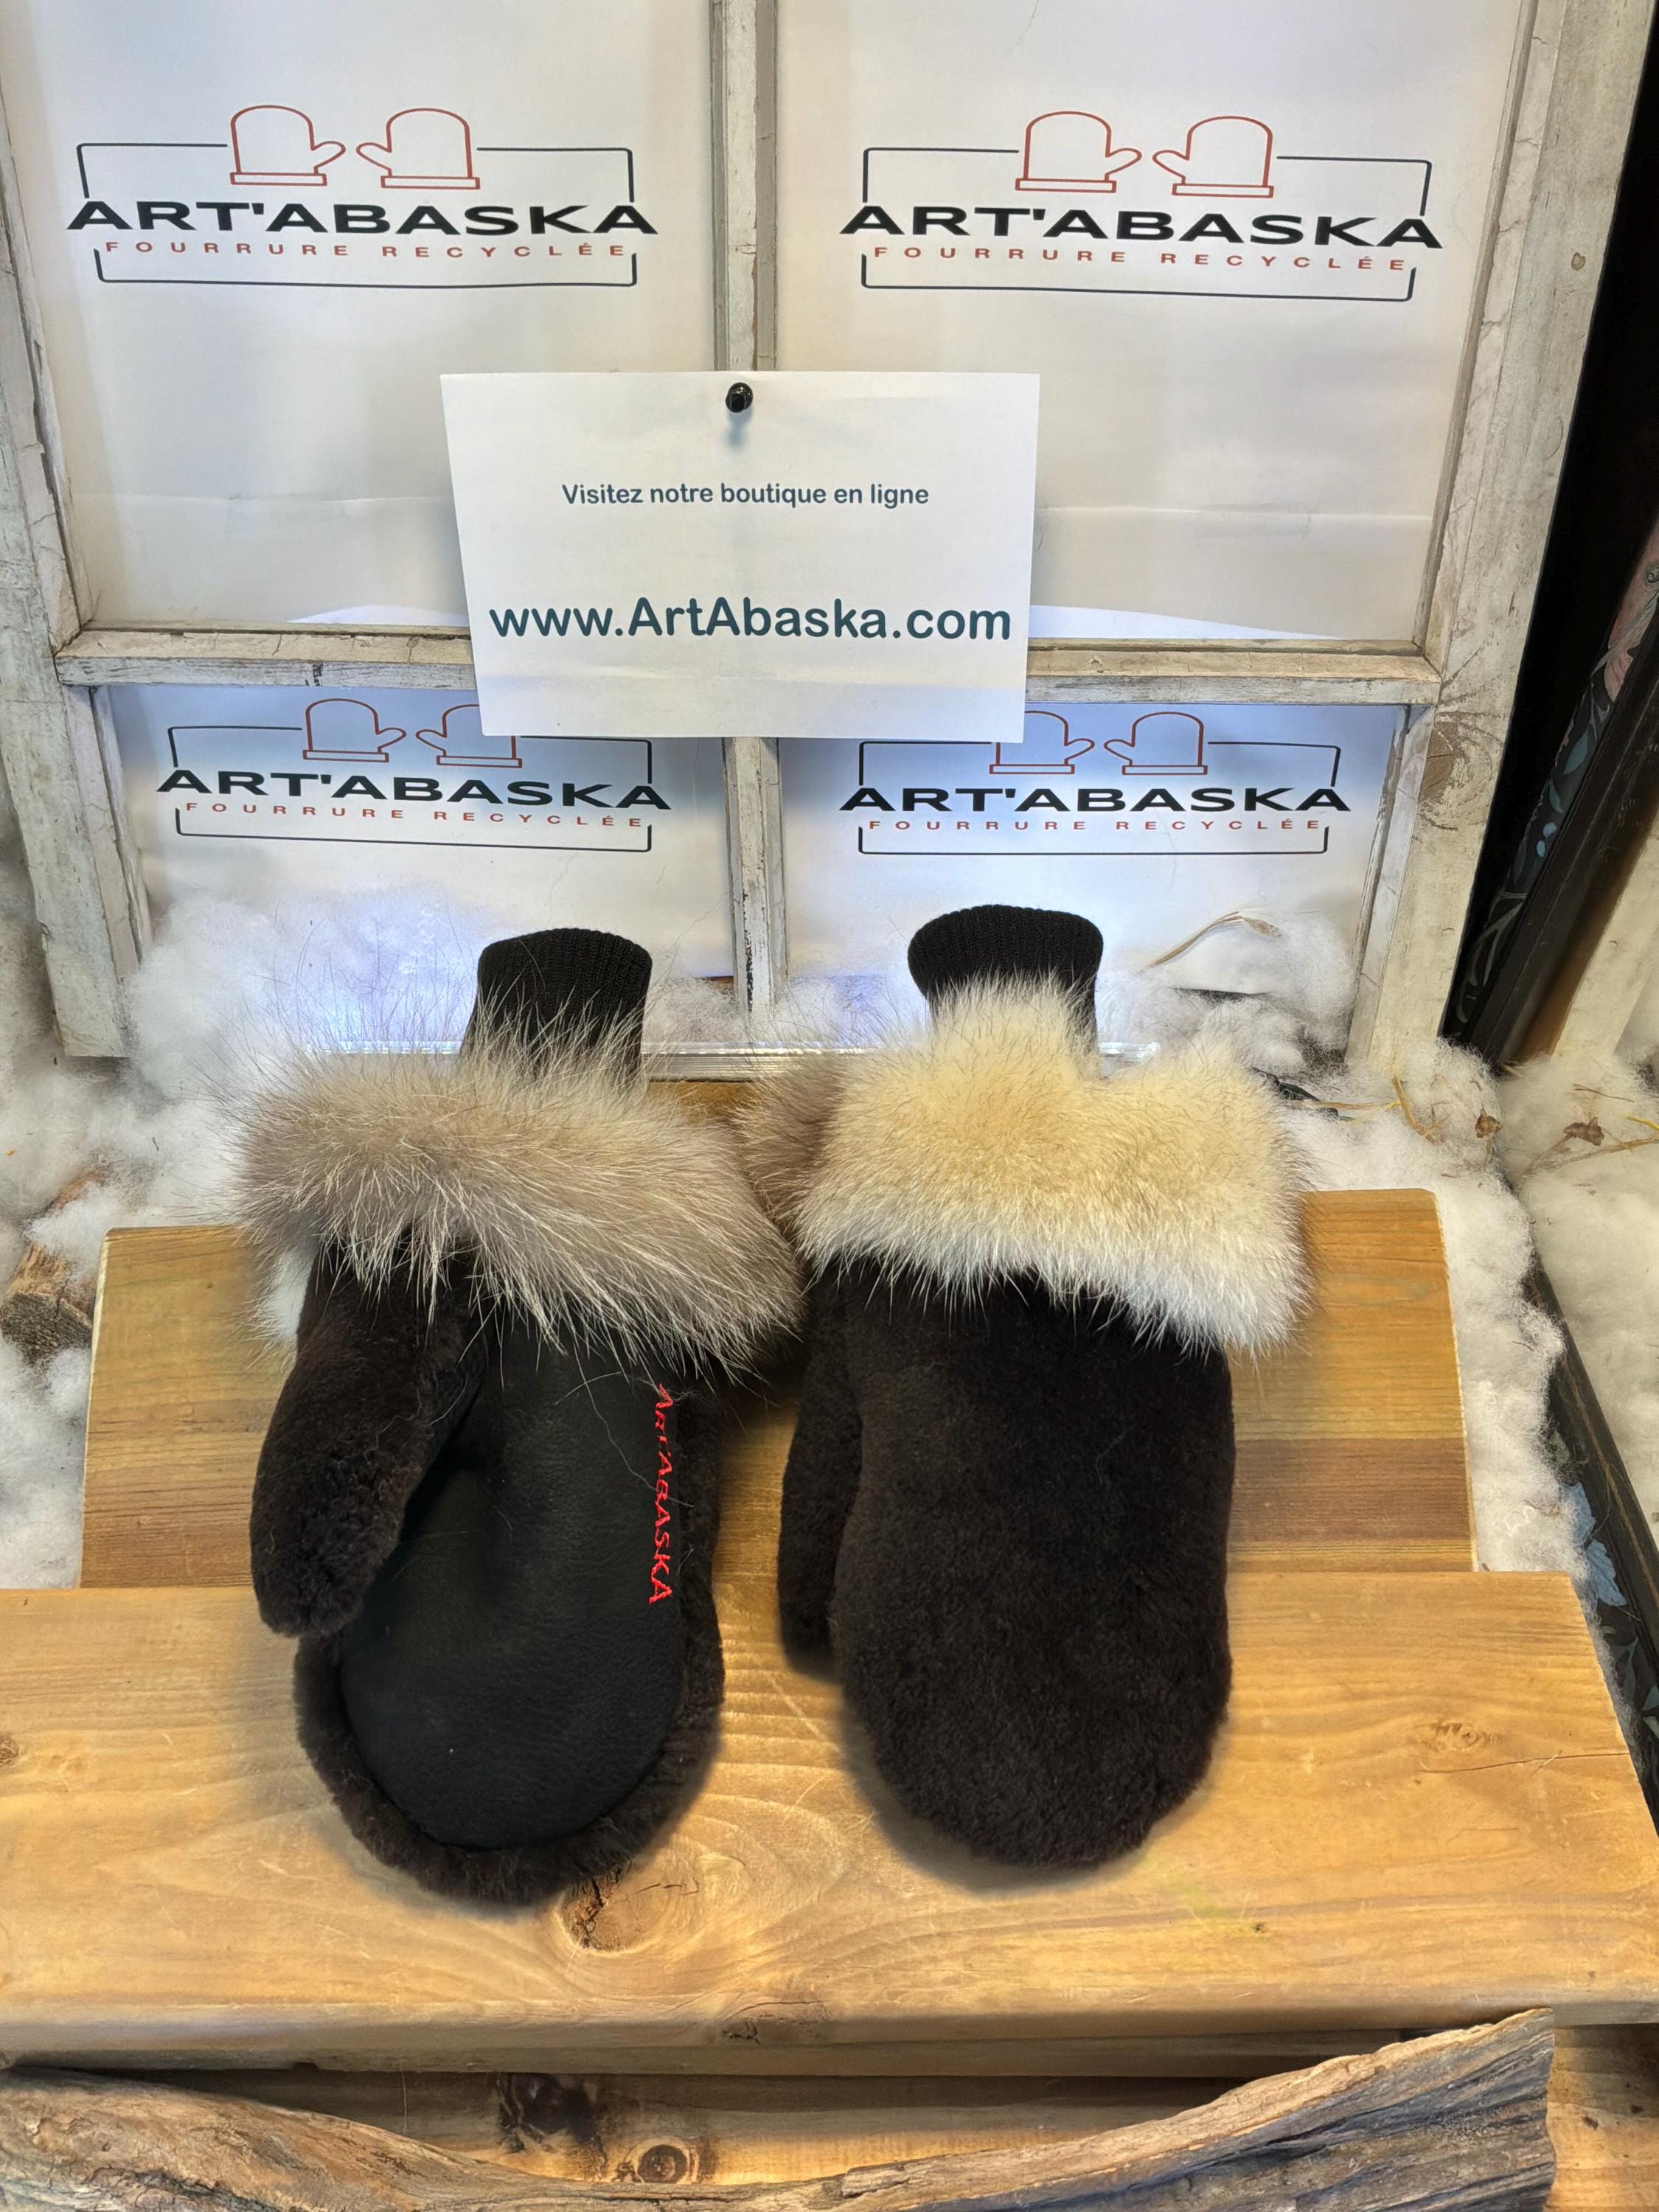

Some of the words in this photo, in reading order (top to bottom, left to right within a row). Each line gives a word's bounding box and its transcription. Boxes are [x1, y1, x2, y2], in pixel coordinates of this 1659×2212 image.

[66, 201, 658, 236] ART'ABASKA
[840, 205, 1443, 249] ART'ABASKA
[105, 242, 348, 256] FOURRURE
[382, 243, 624, 258] RECYCLÉE
[874, 247, 1126, 262] FOURRURE
[1161, 252, 1404, 271] RECYCLÉE
[562, 484, 644, 504] Visitez
[650, 484, 713, 504] notre
[721, 483, 827, 509] boutique
[834, 488, 863, 504] en
[871, 484, 929, 509] ligne
[488, 596, 1011, 641] www.ArtAbaska.com
[156, 769, 671, 810] ART'ABASKA
[839, 787, 1351, 813] ART'ABASKA
[186, 802, 403, 819] FOURRURE
[434, 810, 641, 827] RECYCLÉE
[869, 821, 1085, 831] FOURRURE
[1116, 818, 1320, 830] RECYCLÉE
